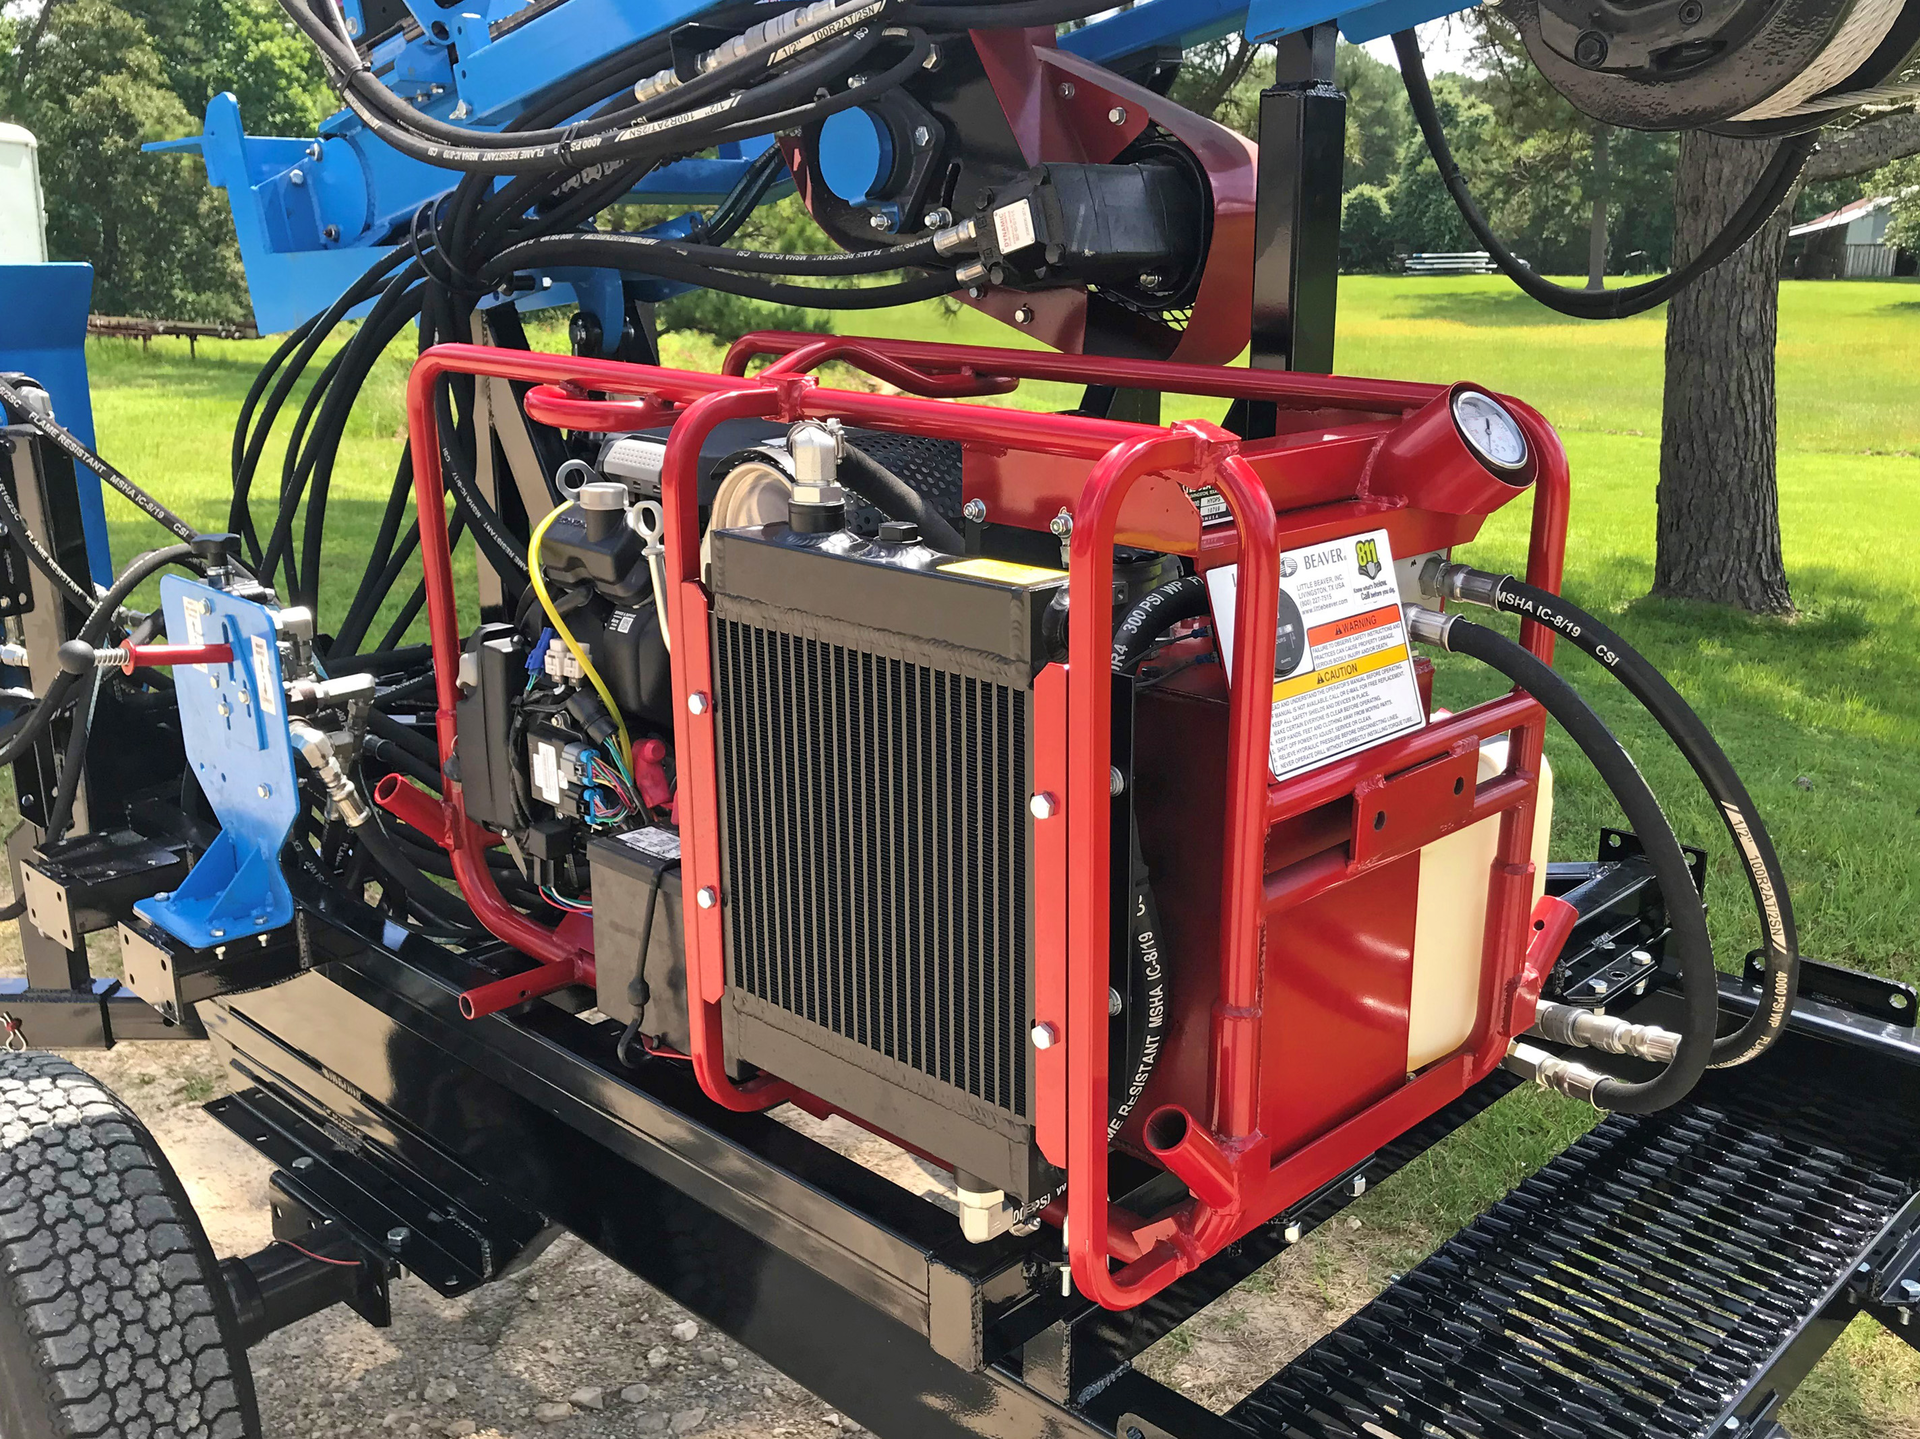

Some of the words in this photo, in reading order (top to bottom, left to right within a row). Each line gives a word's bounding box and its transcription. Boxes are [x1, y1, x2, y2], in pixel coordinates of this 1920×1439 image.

[782, 40, 802, 56] 1/2"
[811, 6, 876, 42] 100R2AT/2SN
[854, 27, 869, 41] CSI
[629, 112, 695, 138] 100R2AT/2SN
[482, 150, 520, 162] RESISTANT
[520, 148, 545, 160] FLAME
[582, 137, 602, 150] 4000
[784, 254, 808, 262] MSHA
[29, 411, 59, 438] FLAME
[58, 433, 107, 473] RESISTANT
[110, 474, 136, 497] MSHA
[136, 493, 165, 519] IC-8/19
[173, 522, 190, 538] CSI
[25, 530, 49, 560] FLAME
[483, 522, 516, 559] RESISTANT
[514, 555, 530, 572] AME
[1354, 538, 1378, 566] 811
[1303, 548, 1344, 570] BEAVER
[1296, 581, 1313, 592] LITTLE
[1314, 576, 1334, 587] BEAVER,
[1298, 587, 1328, 600] LIVINGSTON,
[1335, 582, 1345, 590] USA
[1361, 591, 1371, 601] Call
[1302, 598, 1348, 615] www.littlebeaver.com
[1110, 644, 1129, 671] R4
[1122, 610, 1147, 634] 300
[1139, 592, 1165, 613] PSI
[1160, 580, 1183, 595] WP
[1342, 615, 1377, 633] WARNING
[1498, 590, 1534, 613] MSHA
[1536, 606, 1581, 638] IC-8/19
[1595, 644, 1620, 667] CSI
[1352, 633, 1366, 642] SAFETY
[1324, 663, 1358, 682] CAUTION
[1271, 704, 1280, 712] EAD
[1281, 700, 1290, 708] AND
[1291, 691, 1317, 705] UNDERSTAND
[1272, 720, 1283, 728] KEEP
[1292, 712, 1308, 722] SAFETY
[1308, 705, 1326, 716] SHIELDS
[1334, 697, 1351, 707] DEVICES
[1273, 728, 1286, 736] MAKE
[1286, 722, 1304, 732] CERTAIN
[1304, 714, 1325, 726] EVERYONE
[1330, 708, 1343, 717] CLEAR
[1343, 702, 1359, 713] BEFORE
[1275, 736, 1286, 744] KEEP
[1302, 727, 1313, 735] FEET
[1323, 716, 1343, 728] CLOTHING
[1277, 744, 1288, 753] SHUT
[1289, 741, 1297, 749] OFF
[1298, 736, 1313, 745] POWER
[1335, 722, 1352, 732] SERVICE
[1279, 750, 1296, 760] RELIEVE
[1296, 742, 1319, 754] HYDRAULIC
[1320, 734, 1341, 745] PRESSURE
[1341, 729, 1357, 739] BEFORE
[1280, 759, 1294, 768] NEVER
[1295, 752, 1314, 764] OPERATE
[1314, 749, 1326, 757] DRILL
[1326, 741, 1344, 752] WITHOUT
[1344, 733, 1366, 746] CORRECTLY
[1367, 725, 1388, 737] INSTALLING
[1388, 720, 1403, 729] TORQUE
[1733, 819, 1753, 843] 1/2"
[1749, 854, 1783, 936] 100R2AT/2SN
[1138, 930, 1162, 981] IC-8/19
[1776, 970, 1788, 995] 4000
[1148, 983, 1165, 1029] MSHA
[1772, 996, 1786, 1012] PSI
[1768, 1012, 1783, 1028] WP
[1116, 1034, 1161, 1118] RESISTANT
